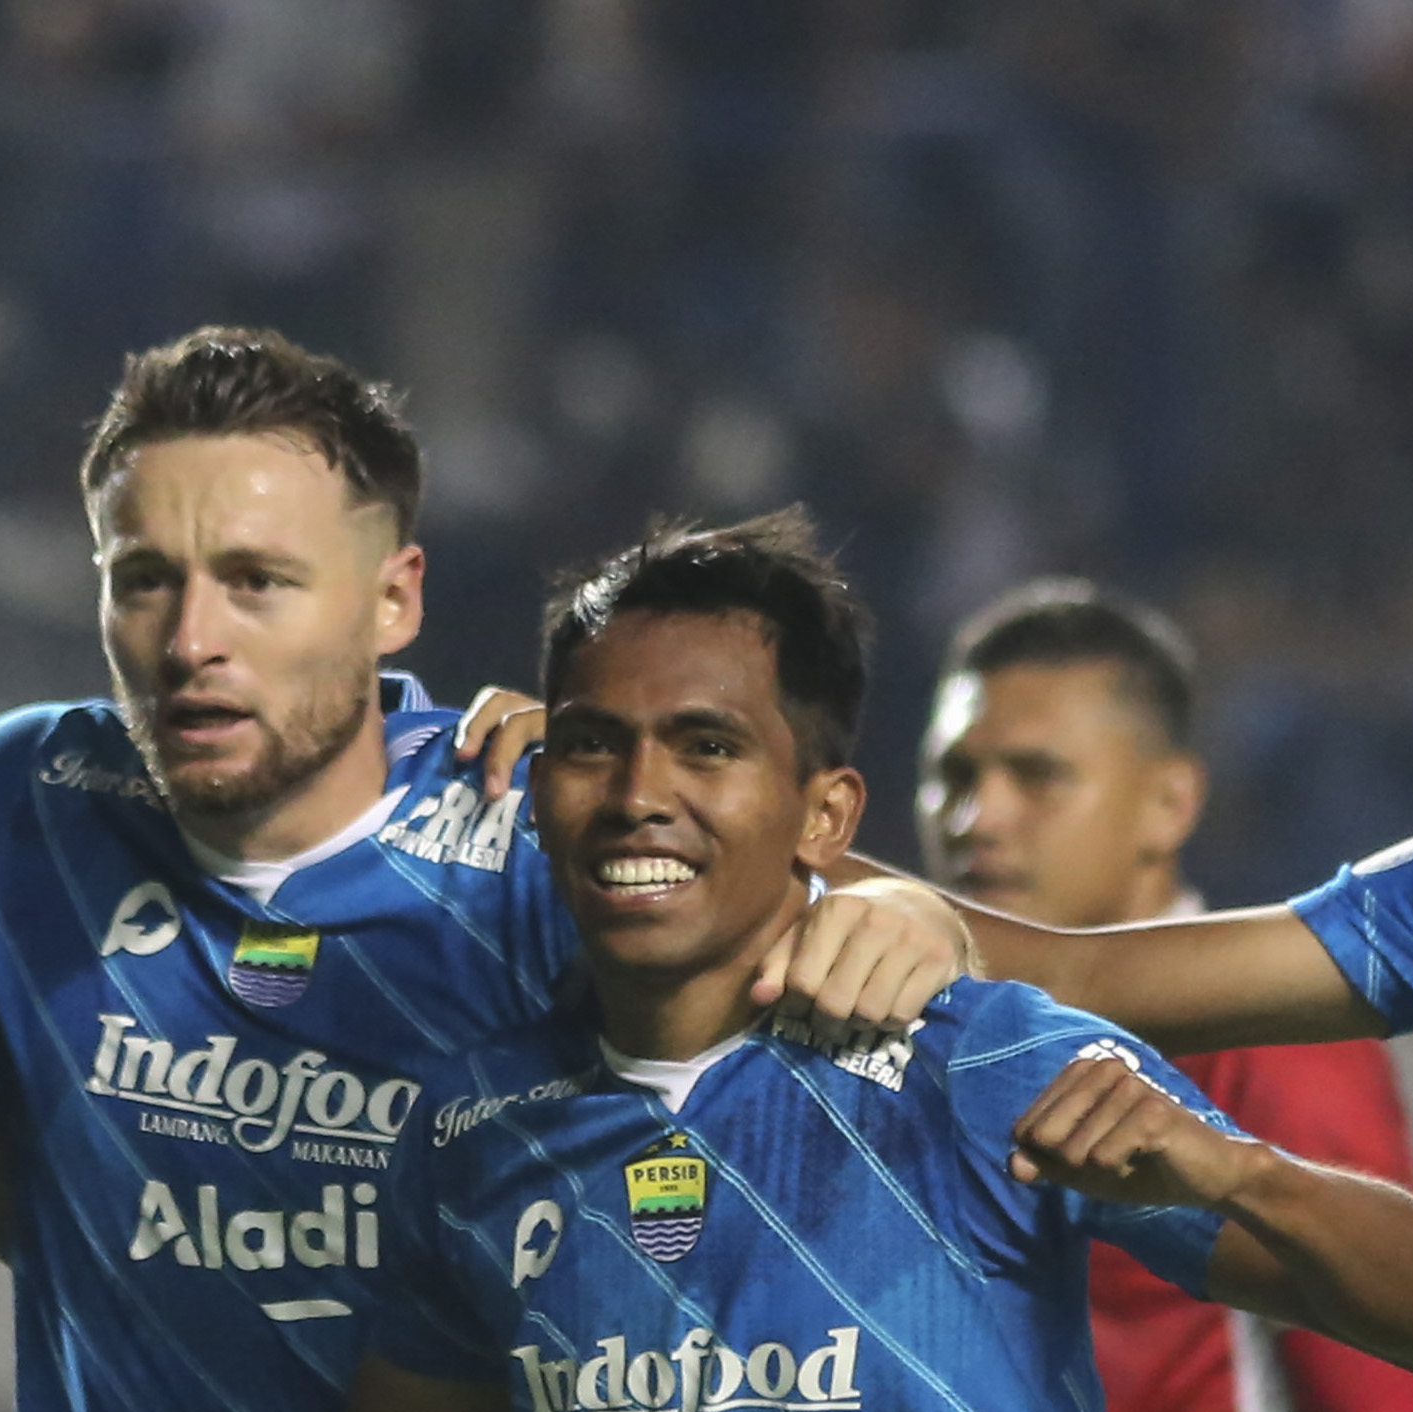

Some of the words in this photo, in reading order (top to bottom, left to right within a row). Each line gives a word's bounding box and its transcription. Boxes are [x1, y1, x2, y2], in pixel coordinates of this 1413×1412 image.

[85, 1013, 422, 1153] Indofoo
[291, 1140, 392, 1170] MAKANAN
[634, 1164, 698, 1183] PERSIB
[129, 1179, 380, 1271] Aladi
